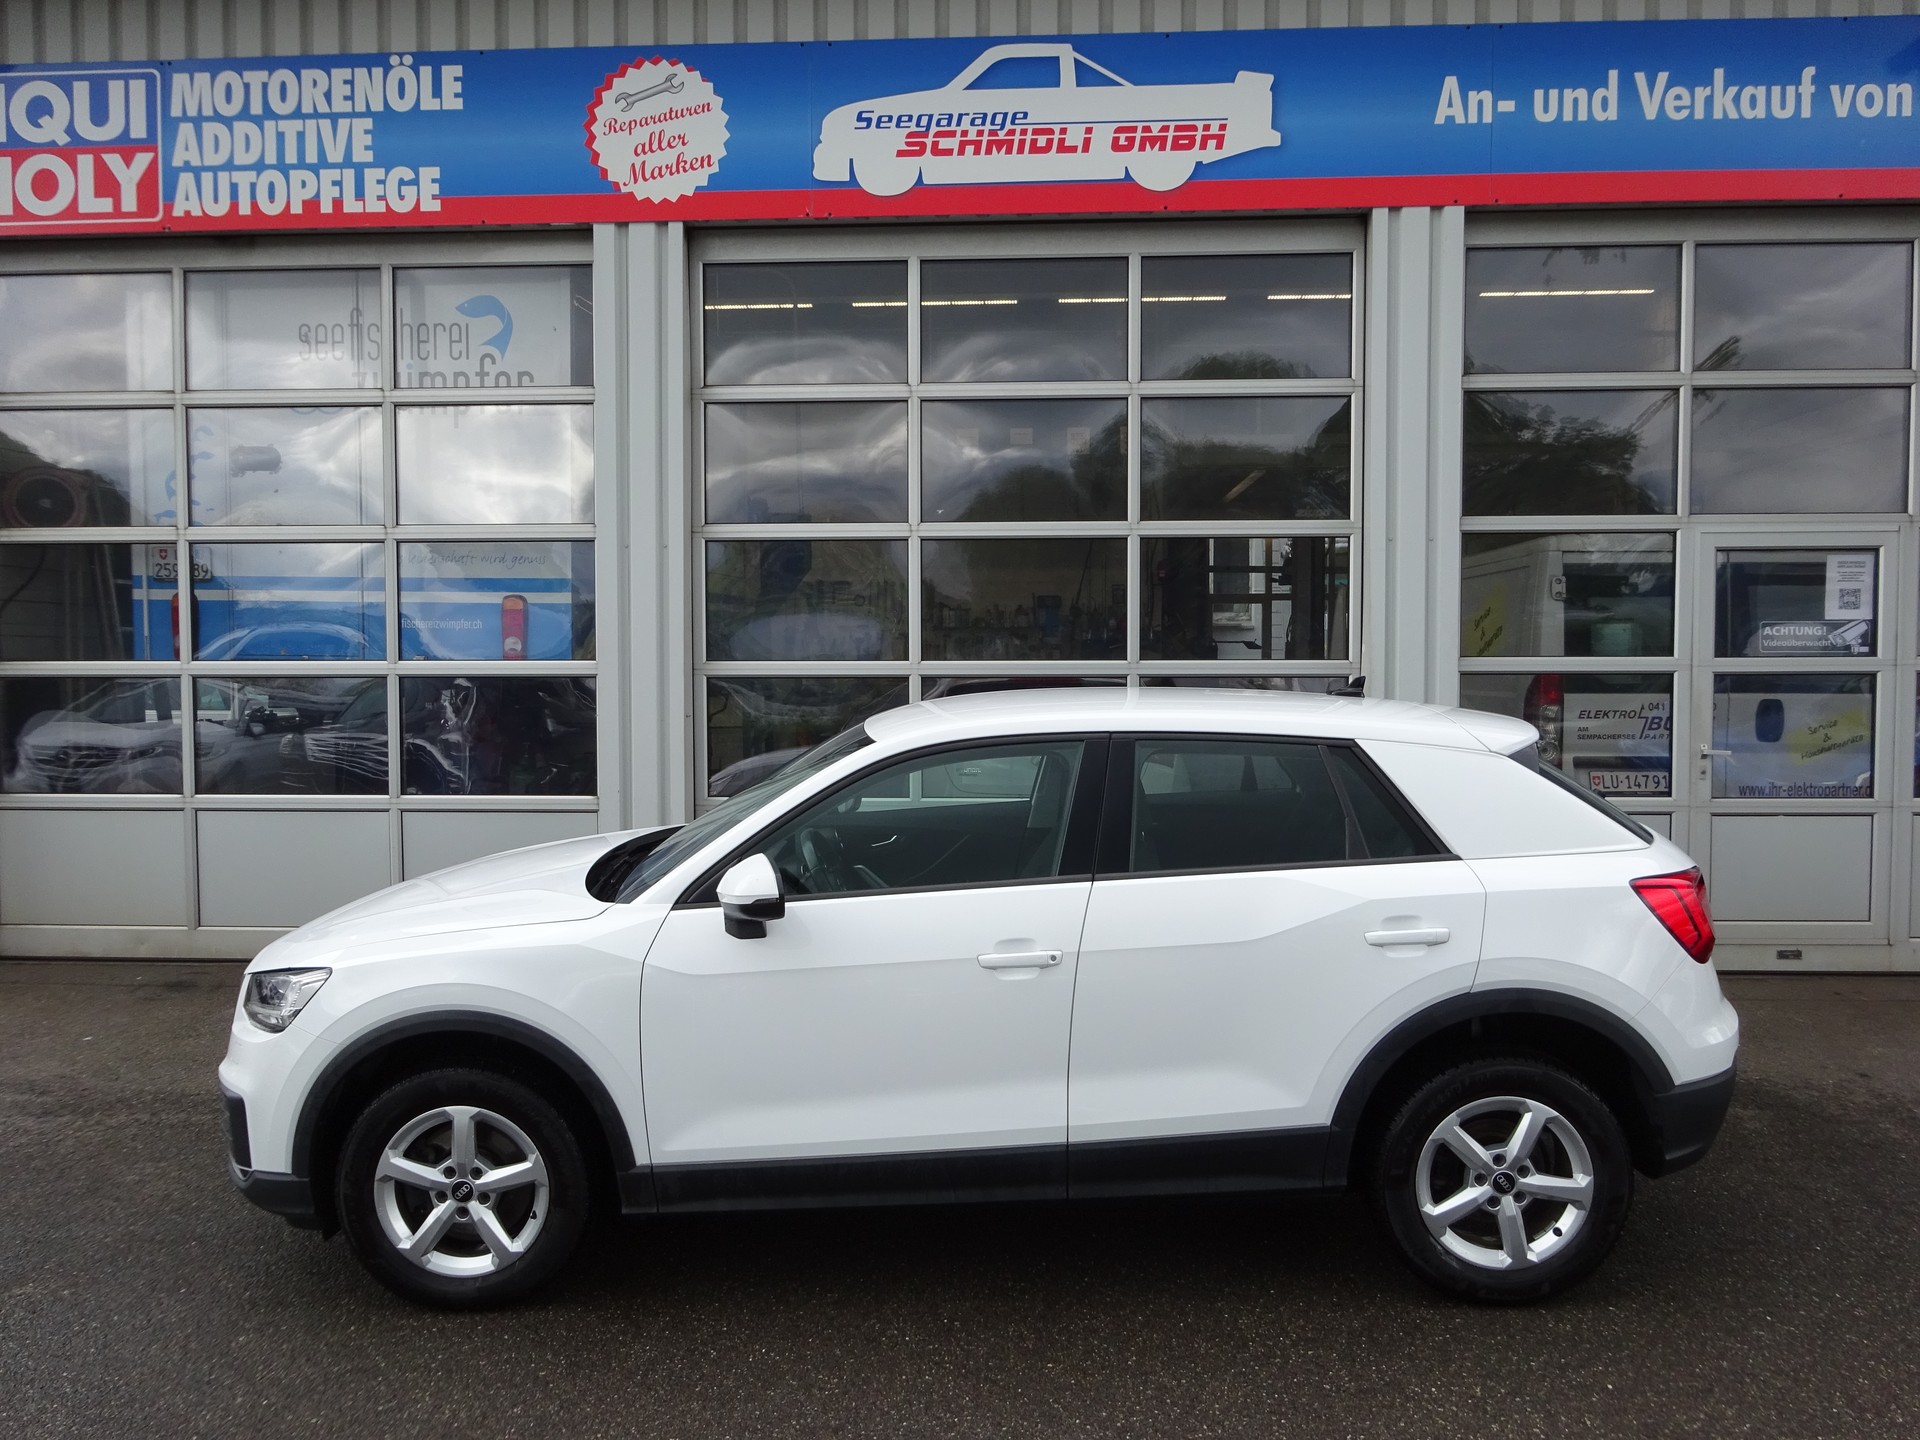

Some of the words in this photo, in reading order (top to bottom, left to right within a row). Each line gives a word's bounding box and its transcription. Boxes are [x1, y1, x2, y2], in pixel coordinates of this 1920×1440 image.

[170, 54, 464, 117] MOTORENÖLE
[1434, 75, 1516, 125] An-
[1533, 69, 1618, 123] und
[1634, 66, 1816, 121] Verkauf
[1829, 81, 1912, 119] von
[0, 80, 147, 146] QUI
[603, 101, 713, 136] Reparaturen
[854, 109, 1029, 133] Seegarage
[172, 117, 374, 167] ADDITIVE
[633, 128, 690, 157] aller
[895, 126, 1094, 158] SCHMIDLI
[1110, 123, 1228, 153] GMBH
[0, 152, 155, 217] OLY
[622, 152, 716, 187] Marken
[172, 166, 442, 217] AUTOPFLEGE
[298, 307, 470, 361] seefisherei
[1763, 626, 1827, 636] ACHTUNG!
[1578, 709, 1638, 720] ELEKTRO
